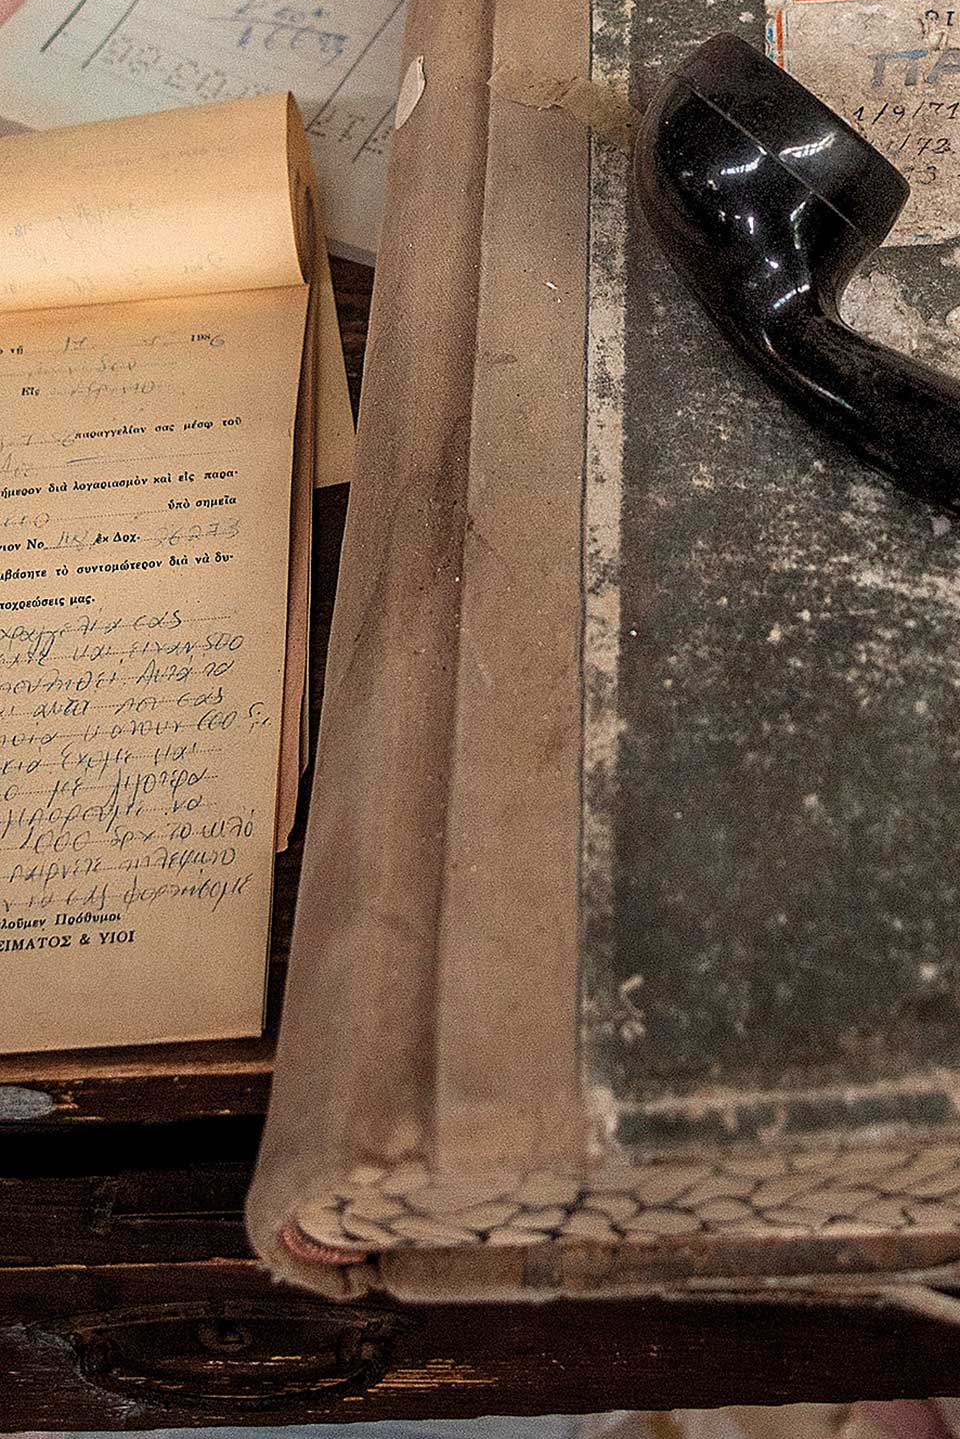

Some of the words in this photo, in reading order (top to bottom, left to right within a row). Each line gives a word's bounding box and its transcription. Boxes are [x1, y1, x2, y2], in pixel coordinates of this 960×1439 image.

[74, 425, 147, 440] παραγγελίαν
[154, 423, 175, 433] σας
[80, 933, 91, 945] &
